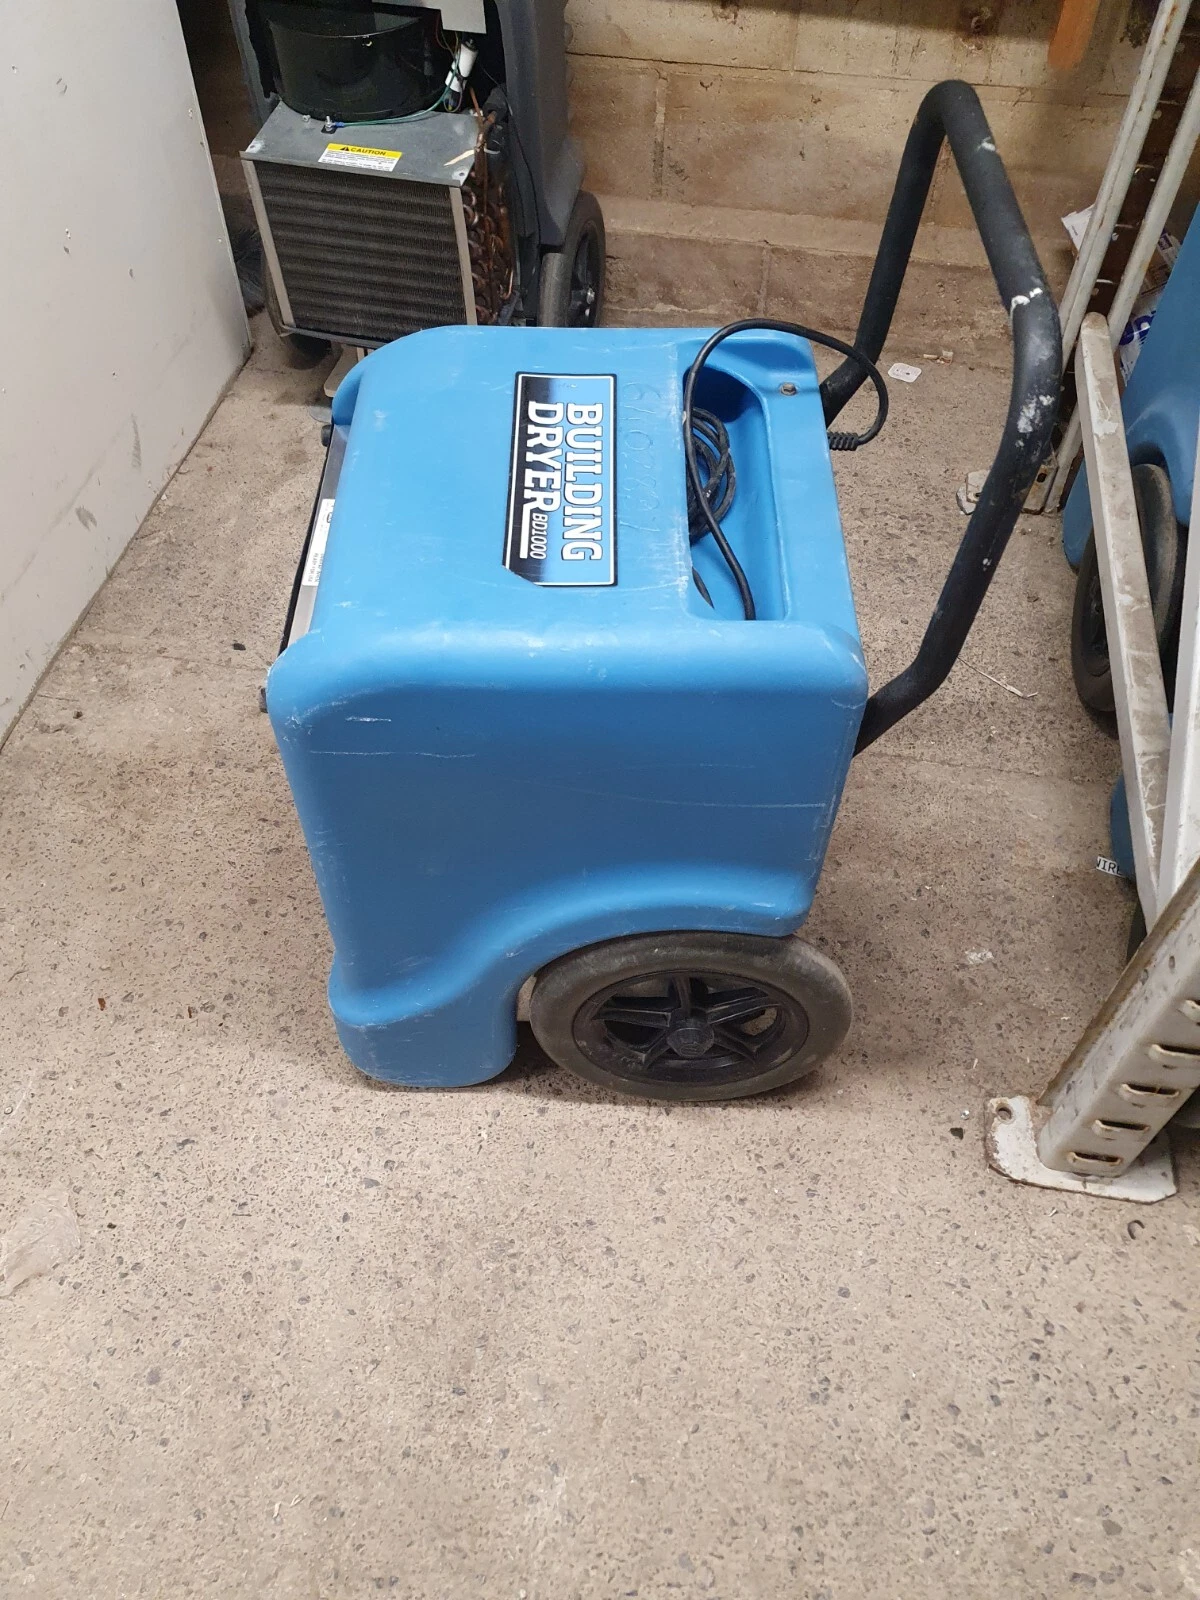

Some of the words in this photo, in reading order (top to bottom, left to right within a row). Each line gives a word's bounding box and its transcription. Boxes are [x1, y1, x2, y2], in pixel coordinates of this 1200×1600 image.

[350, 147, 387, 156] CAUTION
[523, 400, 564, 513] DRYER
[561, 402, 604, 561] BUILDING
[530, 512, 548, 560] BD1000
